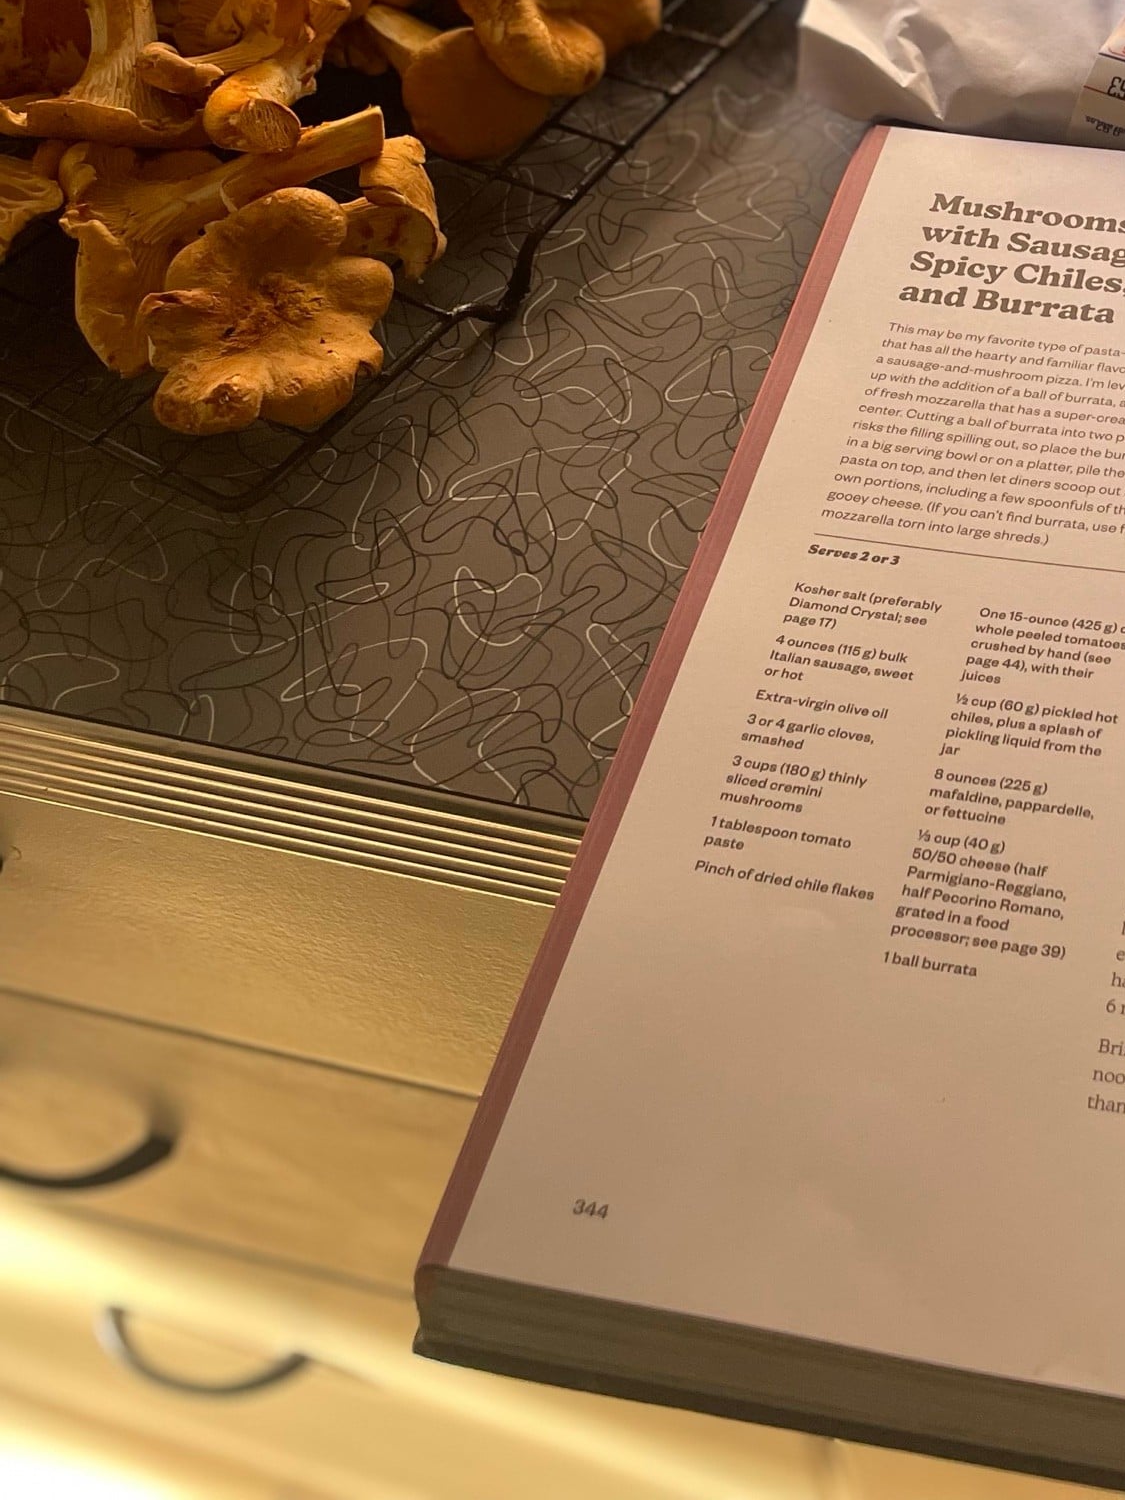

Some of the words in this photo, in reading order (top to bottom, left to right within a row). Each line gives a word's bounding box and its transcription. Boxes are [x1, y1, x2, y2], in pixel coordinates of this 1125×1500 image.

[921, 224, 1000, 250] with
[909, 250, 1008, 285] Spicy
[898, 285, 968, 308] and
[971, 288, 1115, 324] Burrata
[888, 321, 915, 334] This
[916, 327, 945, 340] may
[945, 329, 963, 340] be
[964, 333, 986, 344] my
[986, 333, 1035, 349] favorite
[1037, 341, 1067, 353] type
[1068, 343, 1085, 353] of
[881, 338, 907, 350] that
[908, 340, 933, 353] has
[934, 344, 950, 355] all
[951, 346, 973, 358] the
[974, 348, 1018, 365] hearty
[1018, 356, 1045, 366] and
[1046, 356, 1095, 371] familiar
[875, 355, 884, 364] a
[886, 357, 1044, 383] sausage-and-mushroom
[1045, 374, 1083, 387] pizza.
[1085, 377, 1105, 389] I'm
[807, 543, 858, 560] Serves
[858, 551, 870, 562] 2
[870, 555, 890, 564] or
[889, 555, 901, 566] 3
[788, 596, 849, 615] Diamond
[850, 605, 903, 624] Crystal;
[903, 615, 927, 626] see
[794, 581, 842, 598] Kosher
[842, 590, 867, 602] salt
[868, 592, 943, 614] (preferably
[782, 614, 817, 627] page
[819, 616, 837, 630] 17)
[775, 634, 785, 645] 4
[786, 638, 835, 653] ounces
[837, 643, 862, 657] (115
[861, 647, 877, 660] g)
[878, 649, 908, 663] bulk
[763, 667, 780, 677] or
[780, 667, 804, 681] hot
[769, 649, 811, 666] Italian
[812, 658, 871, 676] sausage,
[873, 667, 914, 681] sweet
[755, 688, 836, 712] Extra-virgin
[837, 702, 870, 717] olive
[871, 707, 889, 719] oil
[740, 732, 805, 750] smashed
[746, 713, 757, 725] 3
[758, 717, 774, 728] or
[775, 718, 785, 729] 4
[785, 722, 826, 736] garlic
[827, 727, 874, 745] cloves,
[725, 772, 769, 789] sliced
[769, 781, 823, 798] cremini
[732, 754, 743, 767] 3
[743, 759, 778, 773] cups
[779, 762, 810, 778] (180
[809, 767, 826, 782] g)
[828, 770, 868, 789] thinly
[719, 792, 803, 813] mushrooms
[702, 835, 745, 850] paste
[711, 815, 718, 827] 1
[718, 817, 798, 841] tablespoon
[800, 831, 851, 849] tomato
[694, 859, 735, 878] Pinch
[737, 867, 755, 881] of
[754, 870, 794, 887] dried
[794, 877, 829, 893] chile
[831, 882, 874, 901] flakes
[573, 1199, 609, 1219] 344
